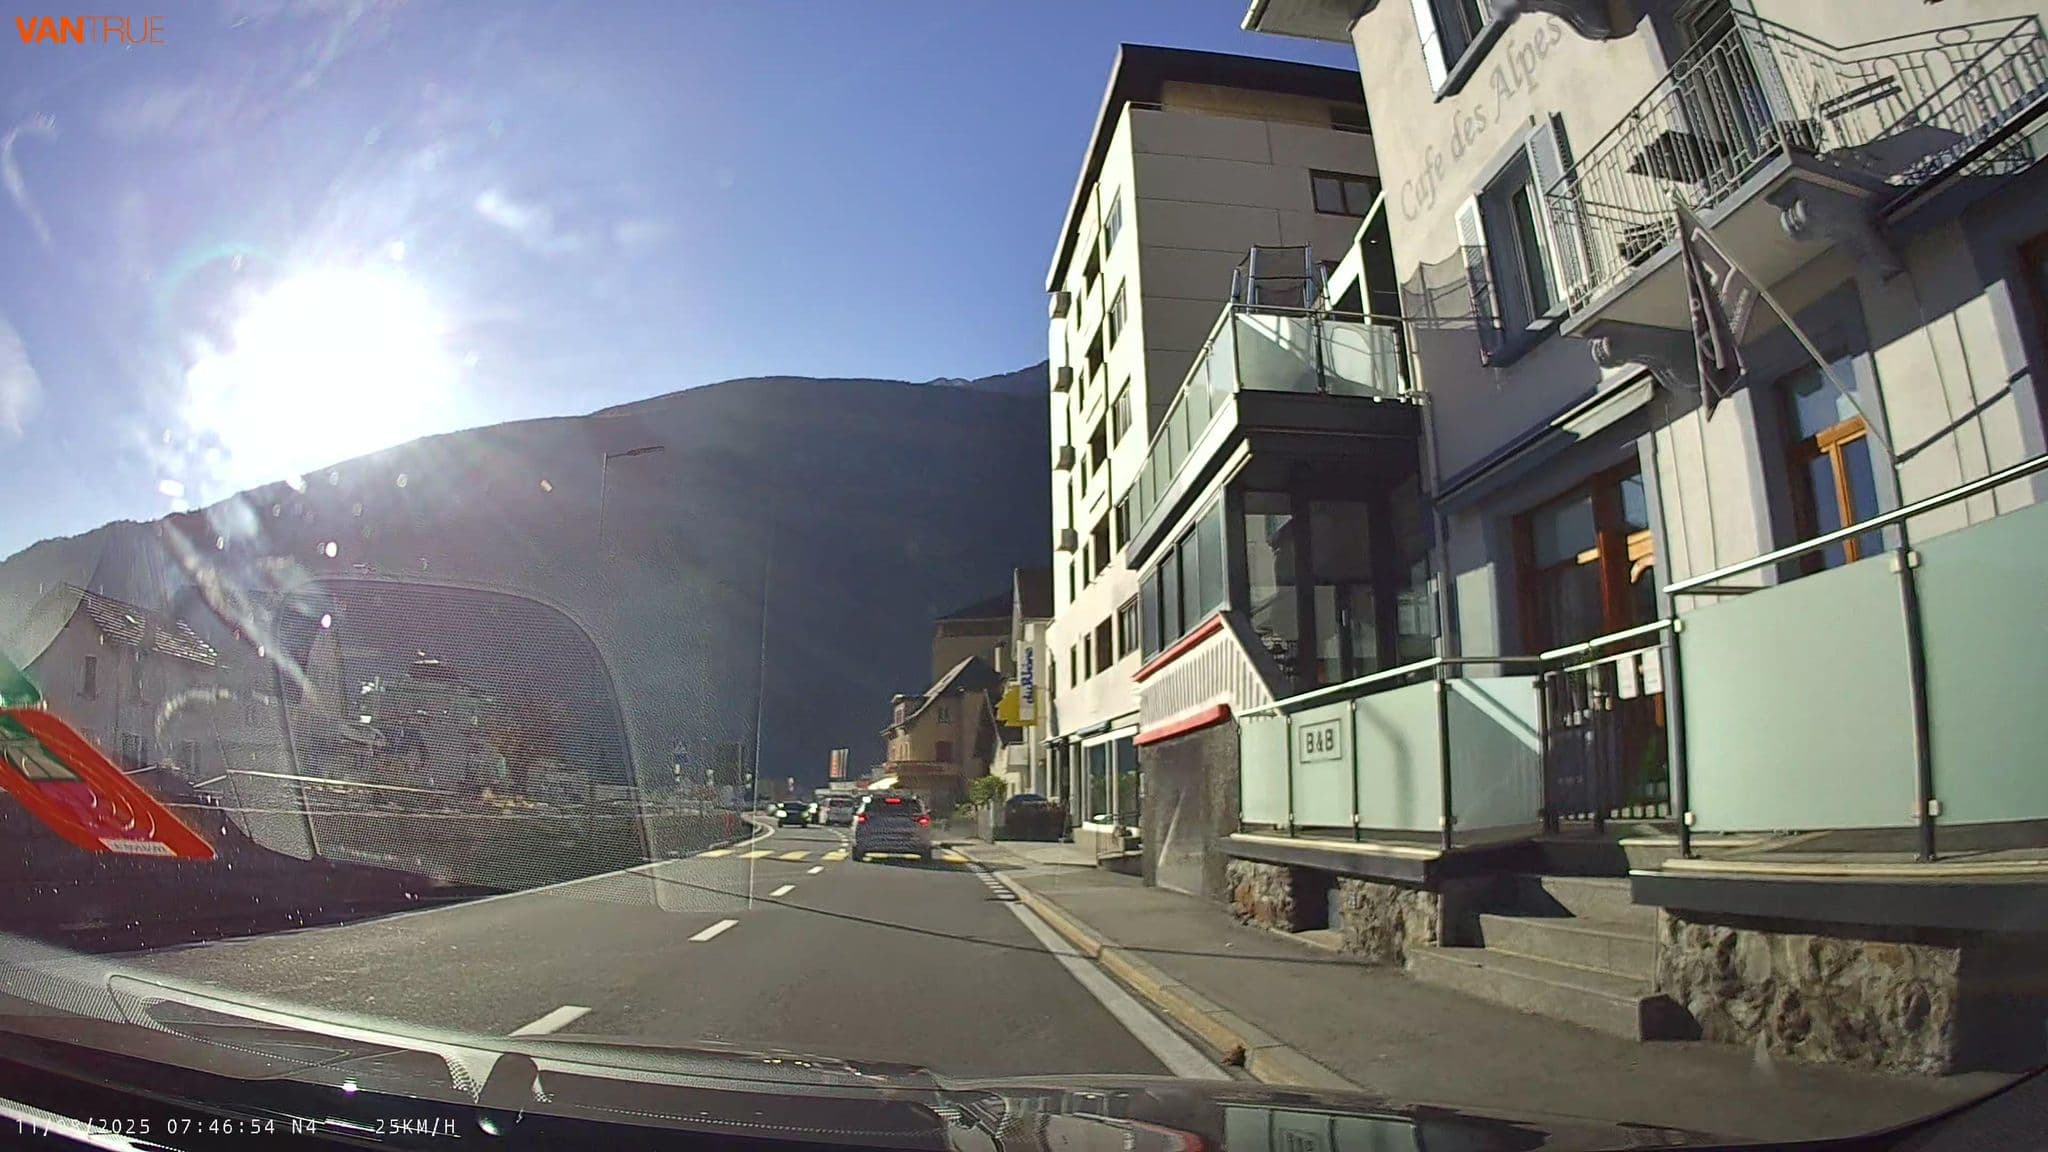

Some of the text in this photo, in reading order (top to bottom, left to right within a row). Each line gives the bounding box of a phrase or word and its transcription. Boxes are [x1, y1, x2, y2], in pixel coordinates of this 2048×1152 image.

[1450, 104, 1488, 162] des
[1489, 15, 1563, 125] Alpes
[1306, 728, 1334, 754] B&B
